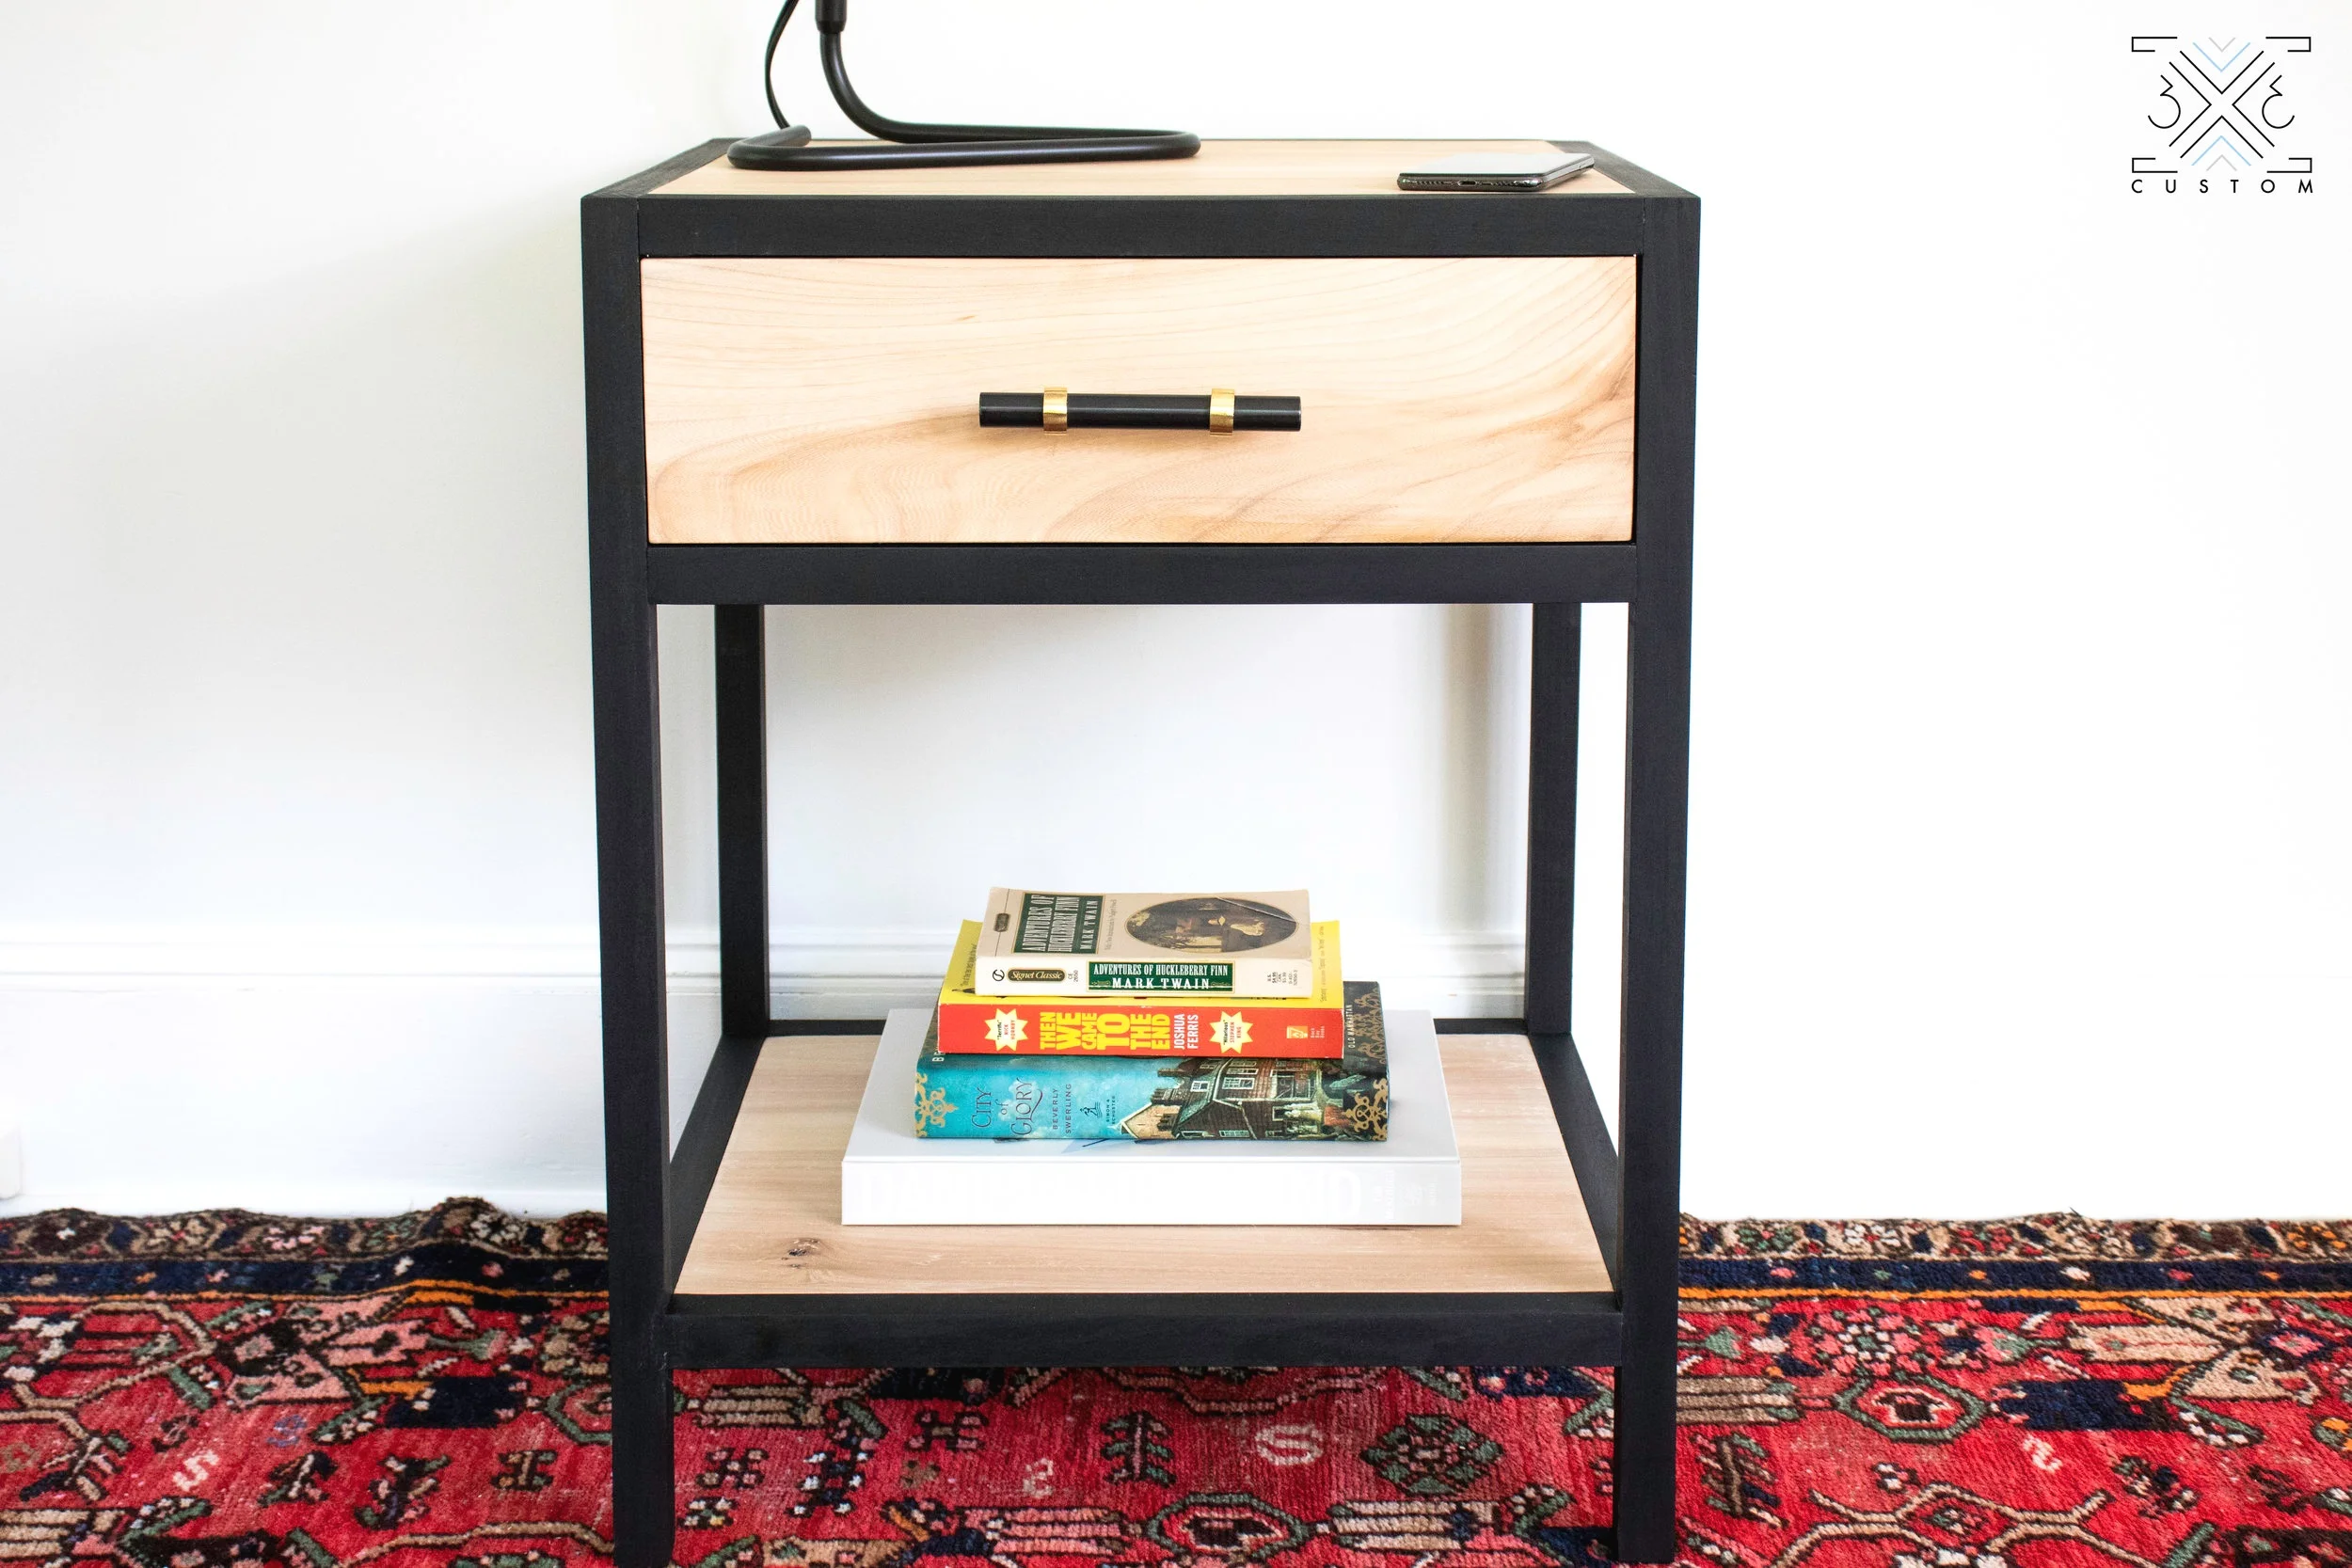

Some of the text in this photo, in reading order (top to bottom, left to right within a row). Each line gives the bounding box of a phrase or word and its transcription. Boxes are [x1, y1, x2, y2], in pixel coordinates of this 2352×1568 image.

[1022, 895, 1055, 952] ADVENTURES OF
[1047, 896, 1080, 952] HUCKLEBERRY FINN
[1079, 900, 1099, 950] MARK TWAIN
[1011, 970, 1063, 981] Signet Classic
[1093, 963, 1228, 976] ADVENTURES OF HUCKLEBERRY FINN
[1112, 977, 1210, 990] MARK TWAIN
[1040, 1012, 1056, 1050] THEN
[1056, 1012, 1082, 1051] WE
[1081, 1013, 1097, 1051] CAME
[1097, 1013, 1130, 1051] TO
[1130, 1013, 1152, 1051] THE
[1152, 1014, 1171, 1050] END
[1174, 1014, 1185, 1050] JOSHUA
[1187, 1014, 1199, 1049] FERRIS
[1345, 1005, 1356, 1049] OLD MANHATTAN
[972, 1087, 992, 1128] CITY
[995, 1099, 1009, 1116] of
[1010, 1077, 1042, 1135] GLORY
